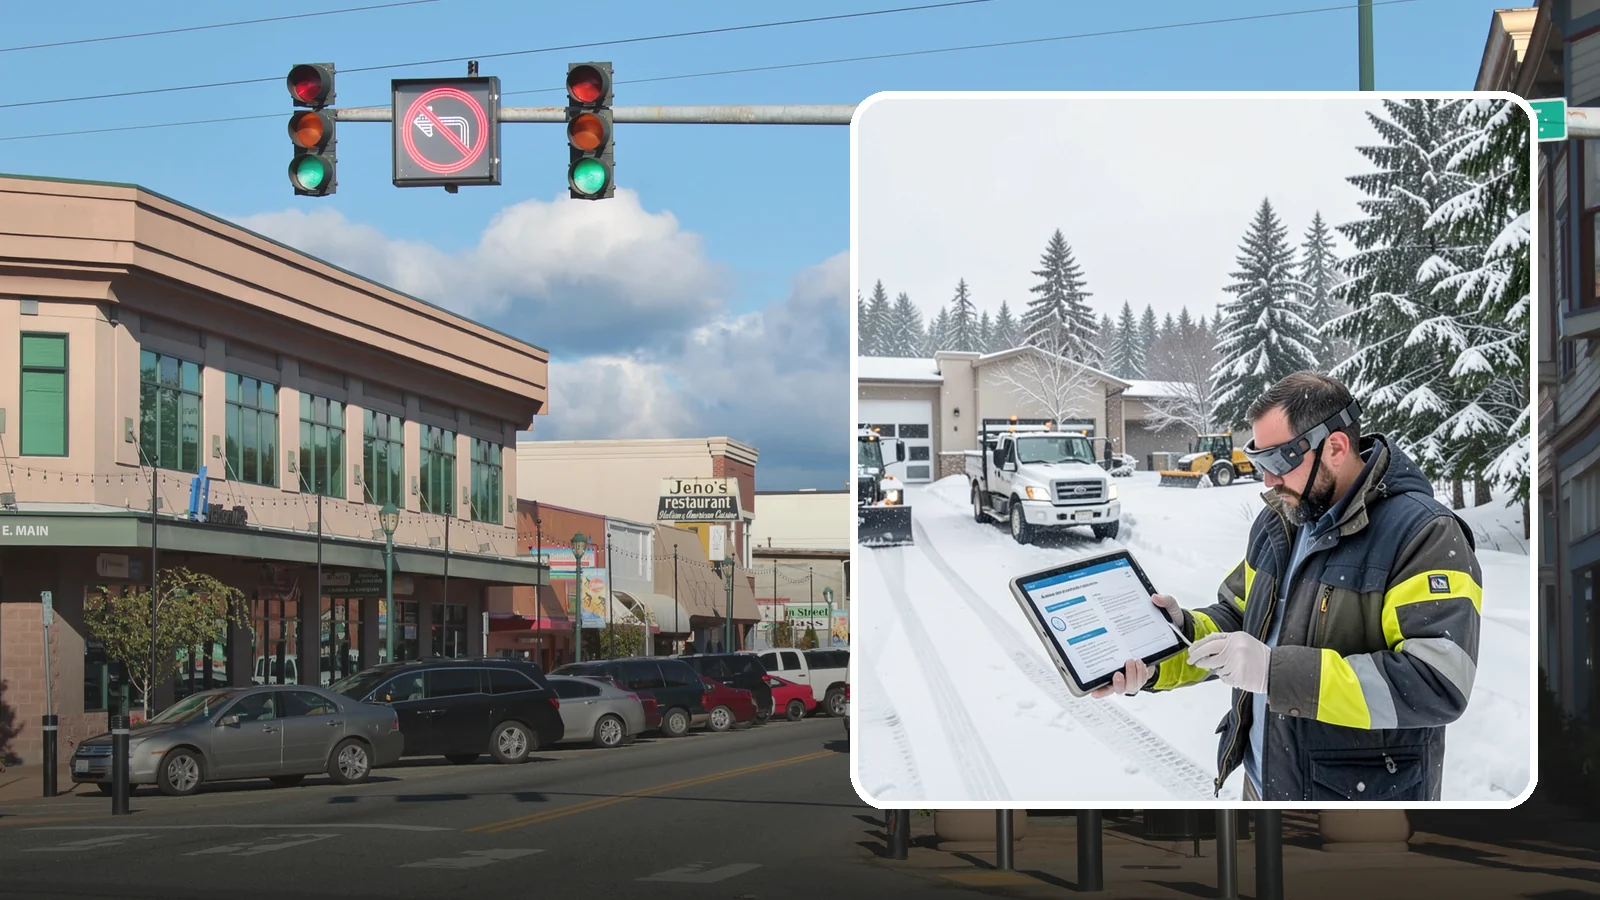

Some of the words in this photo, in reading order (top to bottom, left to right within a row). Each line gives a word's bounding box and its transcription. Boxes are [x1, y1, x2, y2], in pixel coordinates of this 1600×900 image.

[669, 480, 727, 494] Jeno's
[665, 496, 731, 509] restaurant
[659, 510, 682, 519] Italian
[686, 510, 714, 519] American
[715, 509, 737, 519] Cuisine
[2, 525, 13, 536] E.
[15, 525, 49, 536] MAIN
[797, 608, 828, 616] Street
[791, 619, 823, 627] lass
